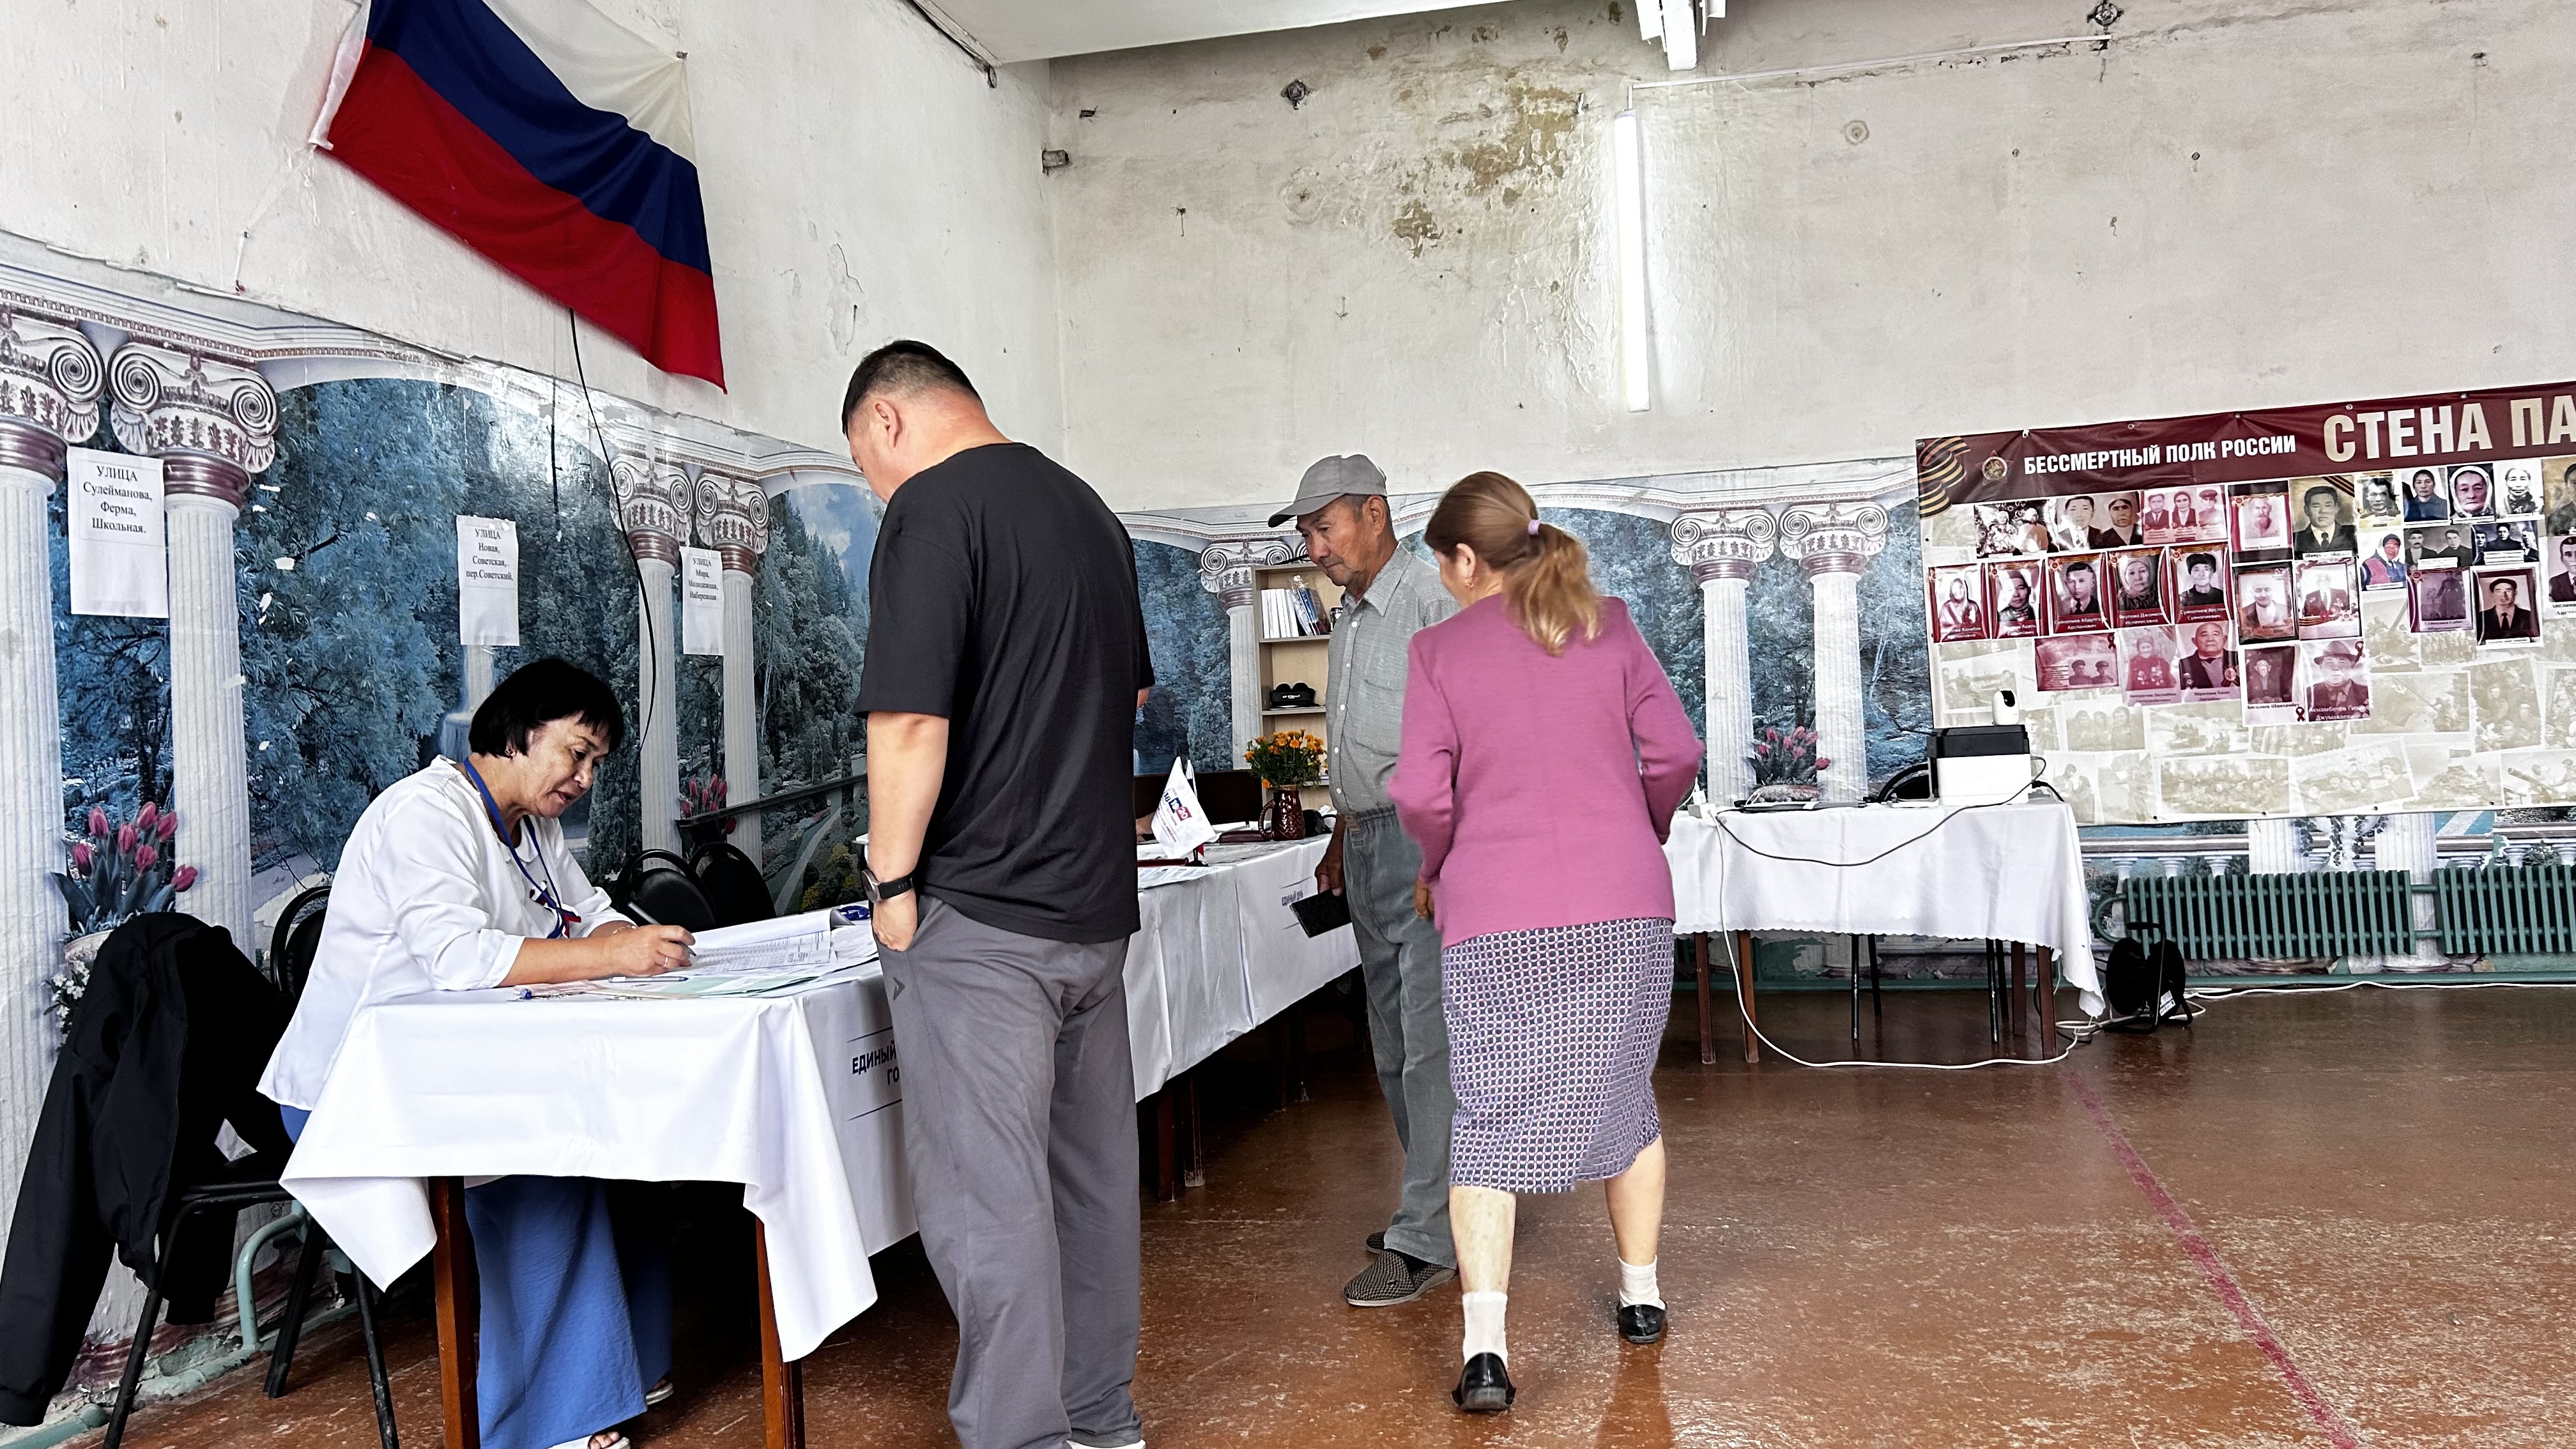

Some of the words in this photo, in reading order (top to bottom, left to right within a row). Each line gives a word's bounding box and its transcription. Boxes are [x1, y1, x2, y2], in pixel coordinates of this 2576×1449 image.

[2324, 402, 2493, 462] СТЕНА
[2510, 394, 2576, 448] ПА
[2024, 443, 2160, 475] БЕССМЕРТНЫЙ
[2165, 442, 2216, 463] ПОЛК
[2221, 434, 2296, 456] РОССИИ
[96, 466, 138, 482] УЛИЦА
[83, 481, 153, 502] Сулейманова,
[100, 501, 136, 516] Ферма,
[92, 517, 146, 533] Школьная.
[475, 528, 502, 540] УЛИЦА
[478, 542, 500, 553] Новая,
[472, 555, 507, 567] Советская,
[692, 557, 712, 567] УЛИЦА
[852, 1039, 897, 1075] ЕДИНЫЙ
[887, 1066, 900, 1085] ГО
